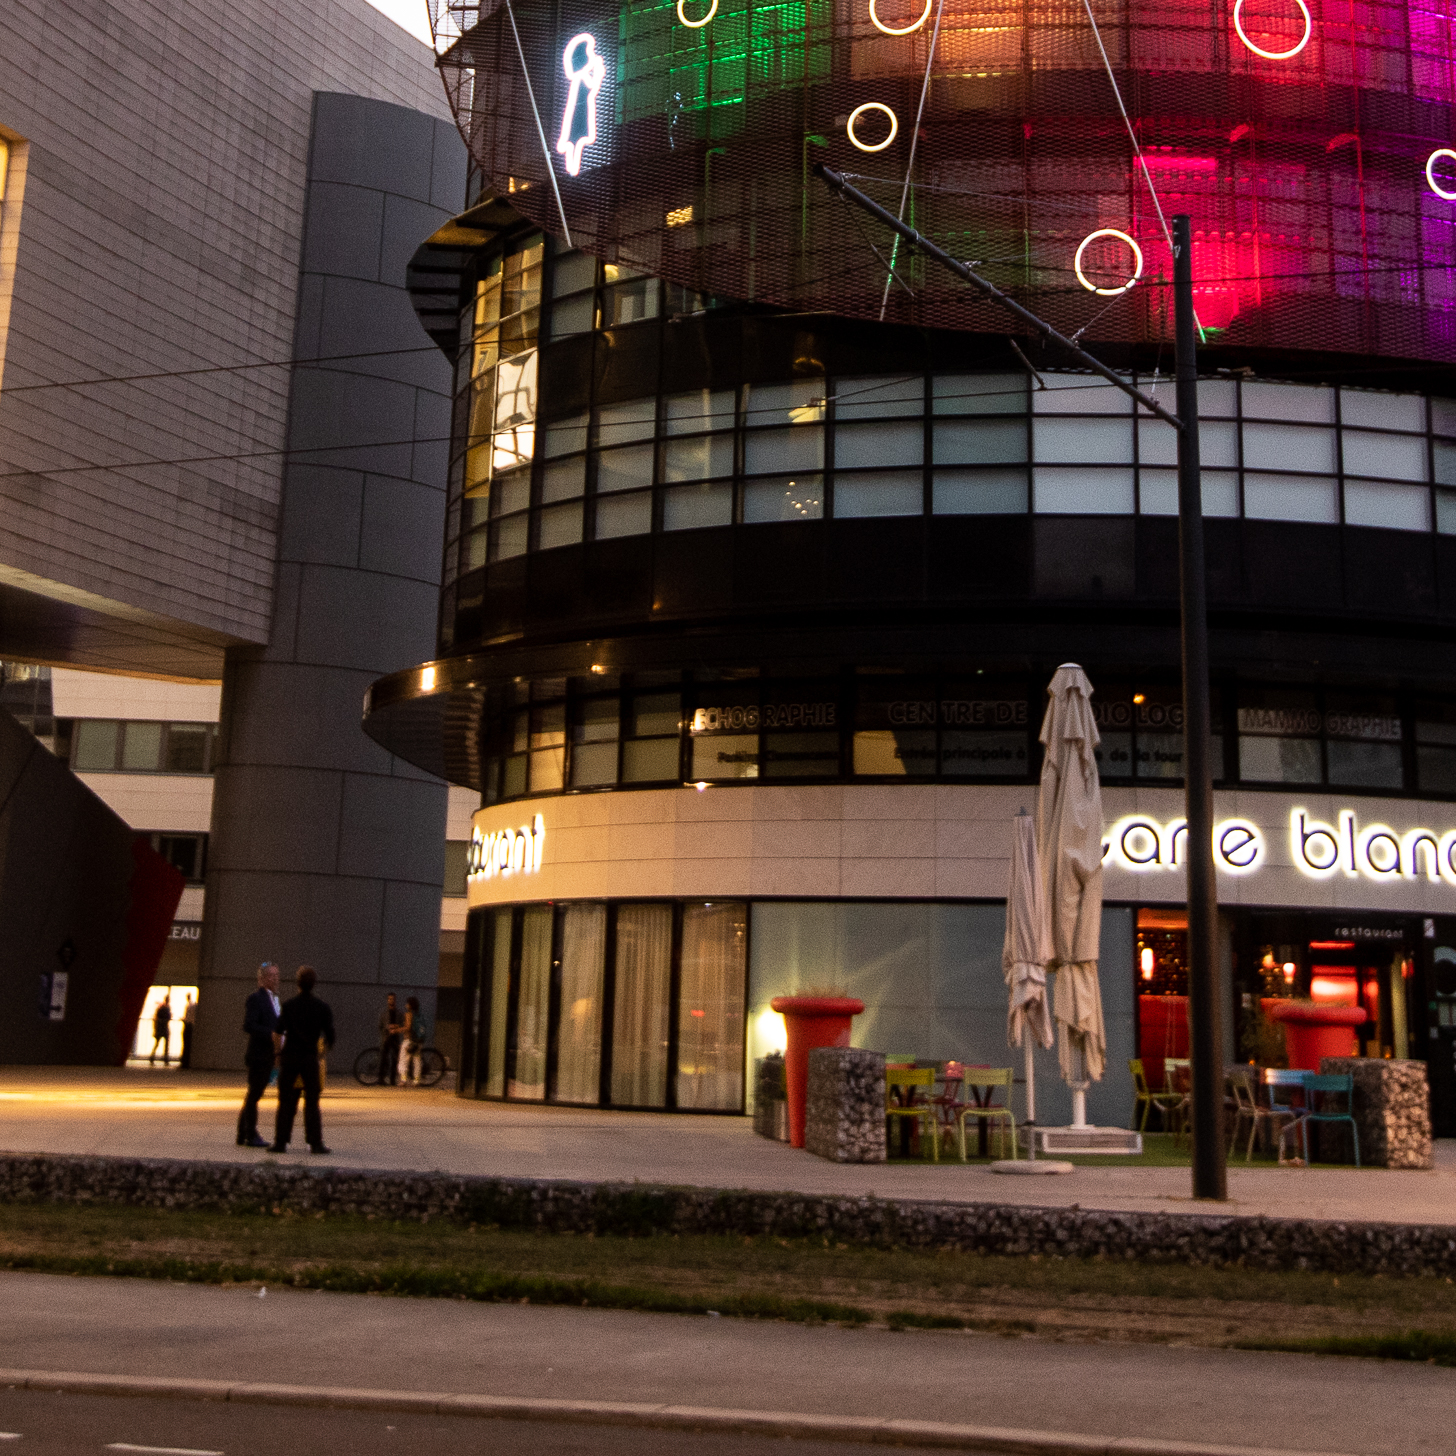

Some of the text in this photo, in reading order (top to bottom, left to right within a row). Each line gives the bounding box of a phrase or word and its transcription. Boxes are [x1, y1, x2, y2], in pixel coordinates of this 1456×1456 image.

[889, 701, 985, 724] CENTRE
[994, 701, 1028, 724] DE
[1243, 707, 1402, 738] MAMMOGRAPHIE
[945, 746, 1012, 762] principale
[168, 926, 200, 940] EAU
[1335, 926, 1403, 939] restaurant
